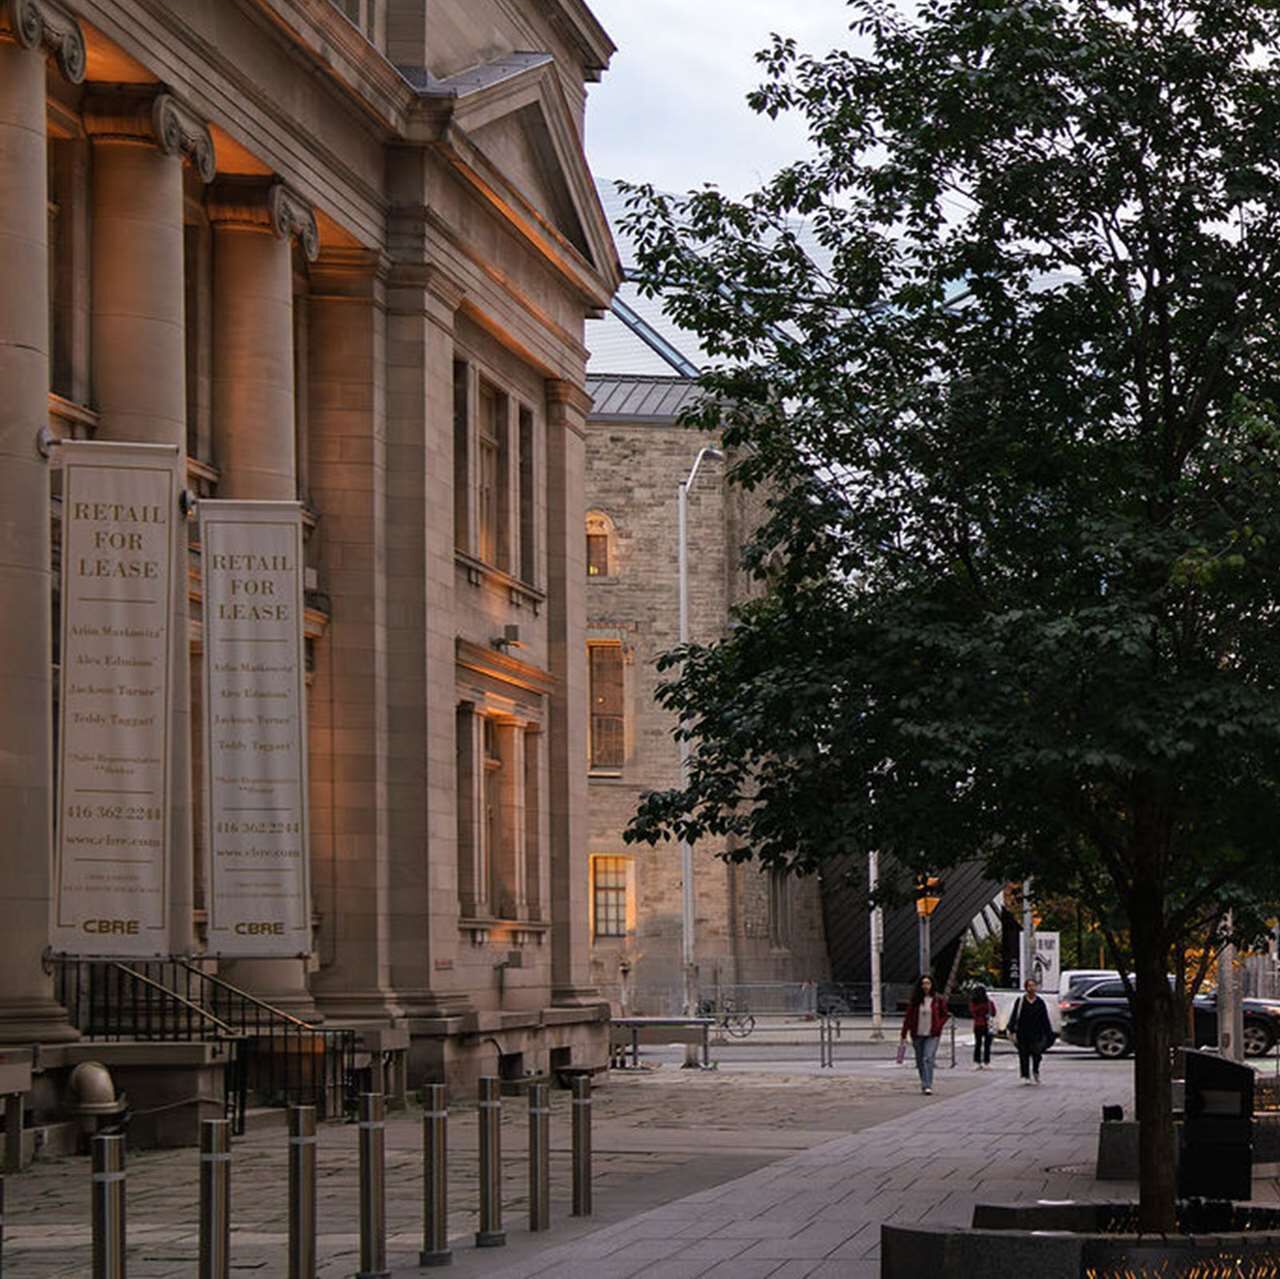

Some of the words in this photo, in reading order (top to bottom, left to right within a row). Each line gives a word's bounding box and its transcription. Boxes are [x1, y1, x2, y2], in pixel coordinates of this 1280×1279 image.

[72, 502, 166, 524] RETAIL
[95, 531, 143, 550] FOR
[78, 558, 159, 578] LEASE
[213, 554, 295, 571] RETAIL
[231, 579, 274, 596] FOR
[219, 604, 289, 620] LEASE
[82, 920, 140, 935] CBRE
[234, 922, 285, 935] CBRE
